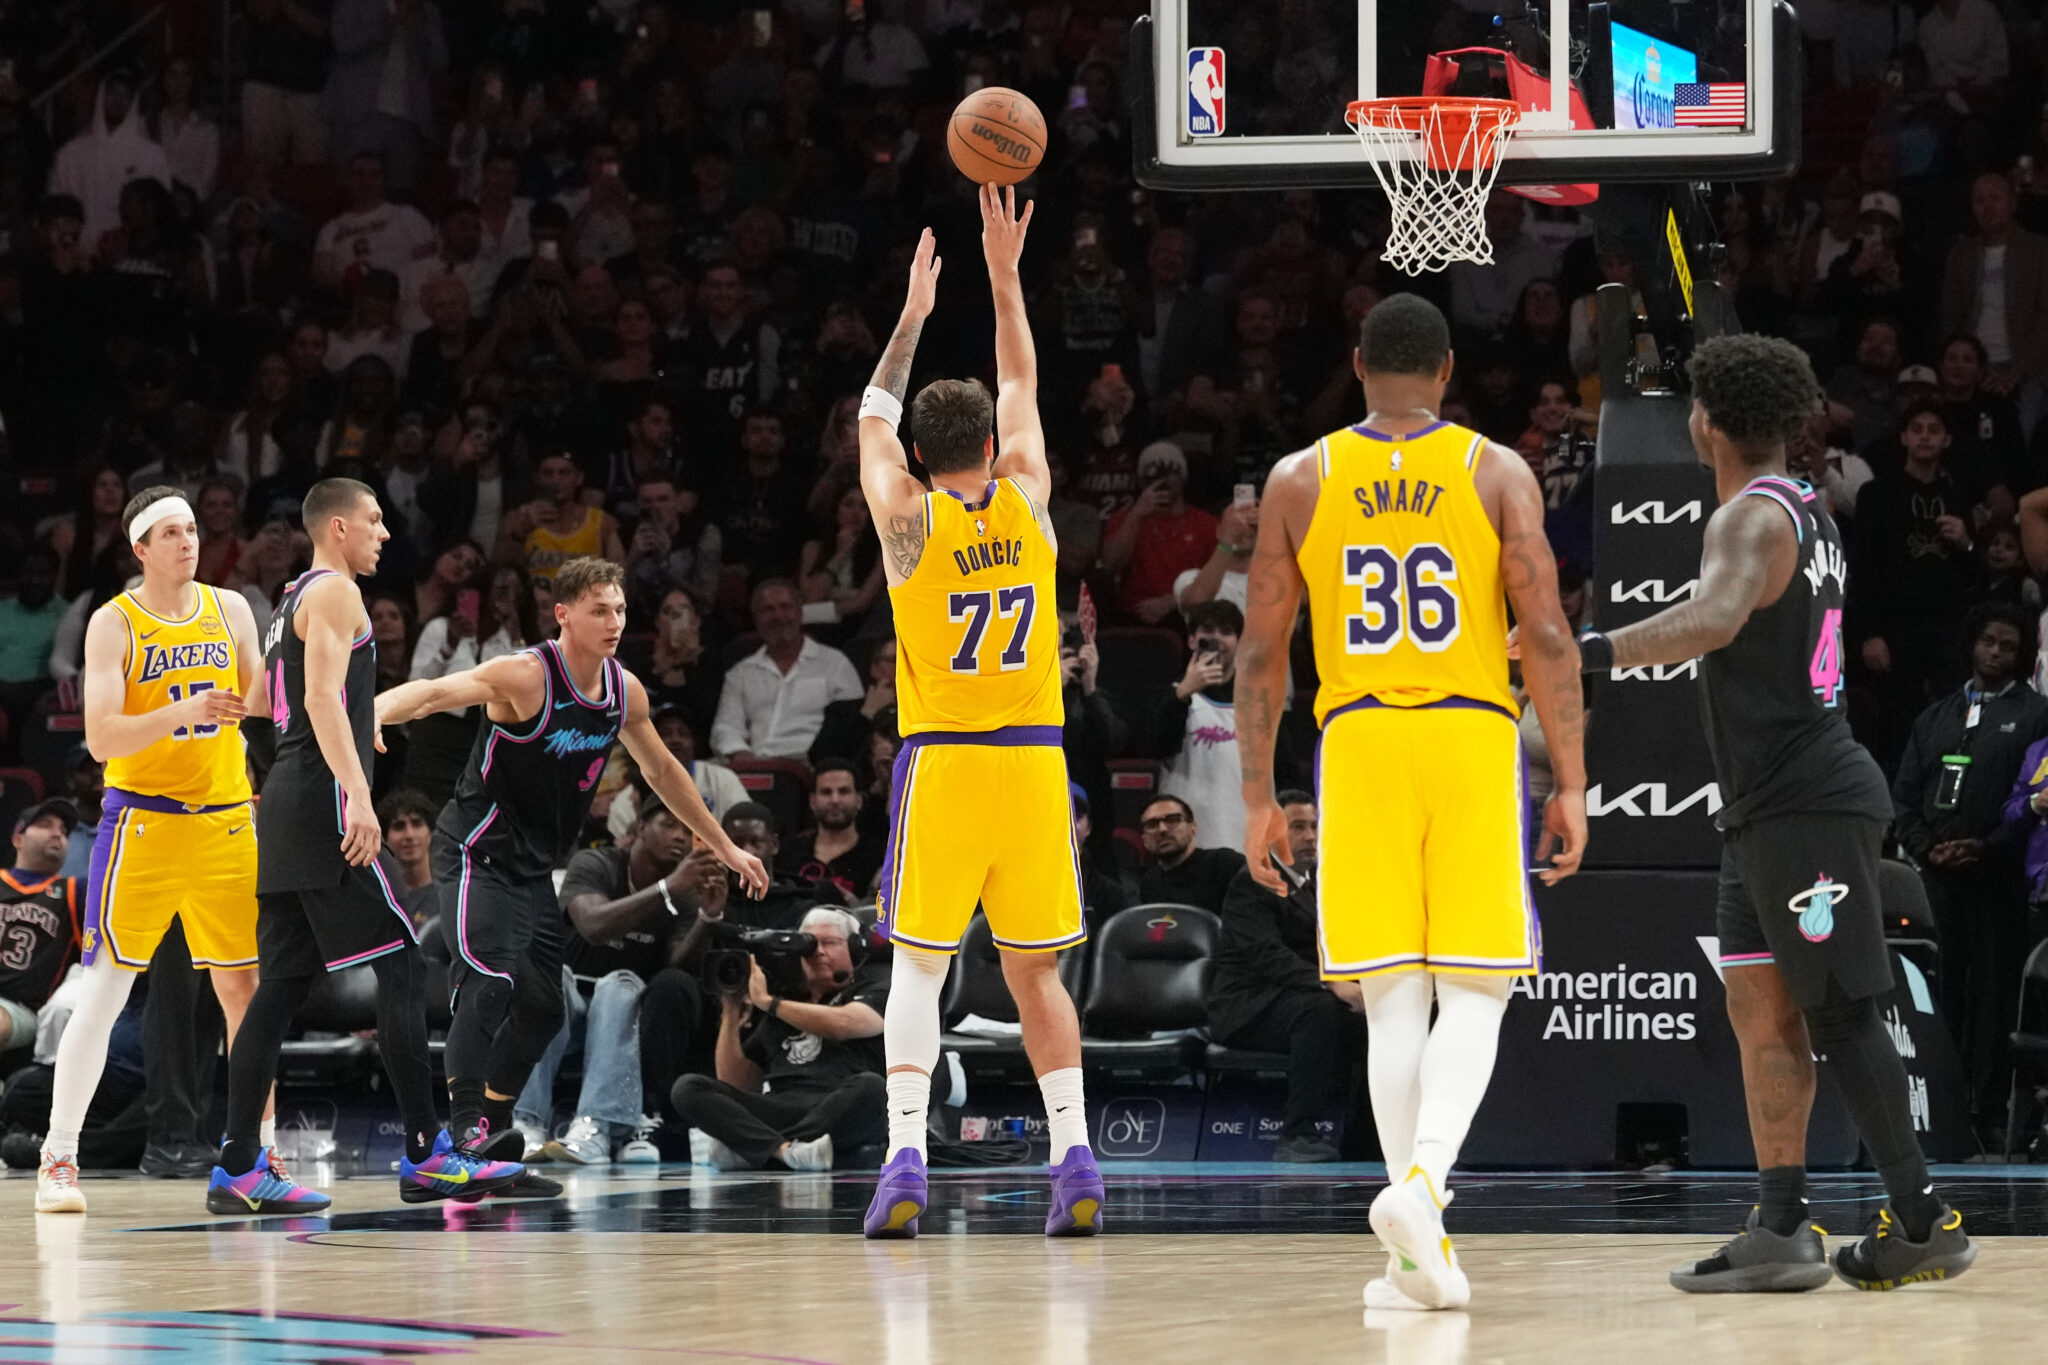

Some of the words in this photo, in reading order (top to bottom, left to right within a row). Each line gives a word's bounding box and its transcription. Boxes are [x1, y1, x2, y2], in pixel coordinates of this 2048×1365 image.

[1192, 116, 1211, 131] NBA
[972, 123, 1031, 163] Wilson
[1355, 479, 1445, 519] SMART
[953, 536, 1023, 577] DONČIĆ
[1343, 541, 1462, 655] 36
[948, 583, 1037, 675] 77
[137, 642, 229, 684] LAKERS
[544, 724, 618, 760] Miami
[577, 756, 606, 791] 9
[1507, 963, 1698, 1000] American
[1542, 1003, 1698, 1041] Airlines
[1107, 1109, 1156, 1144] ONE
[1212, 1121, 1244, 1135] ONE
